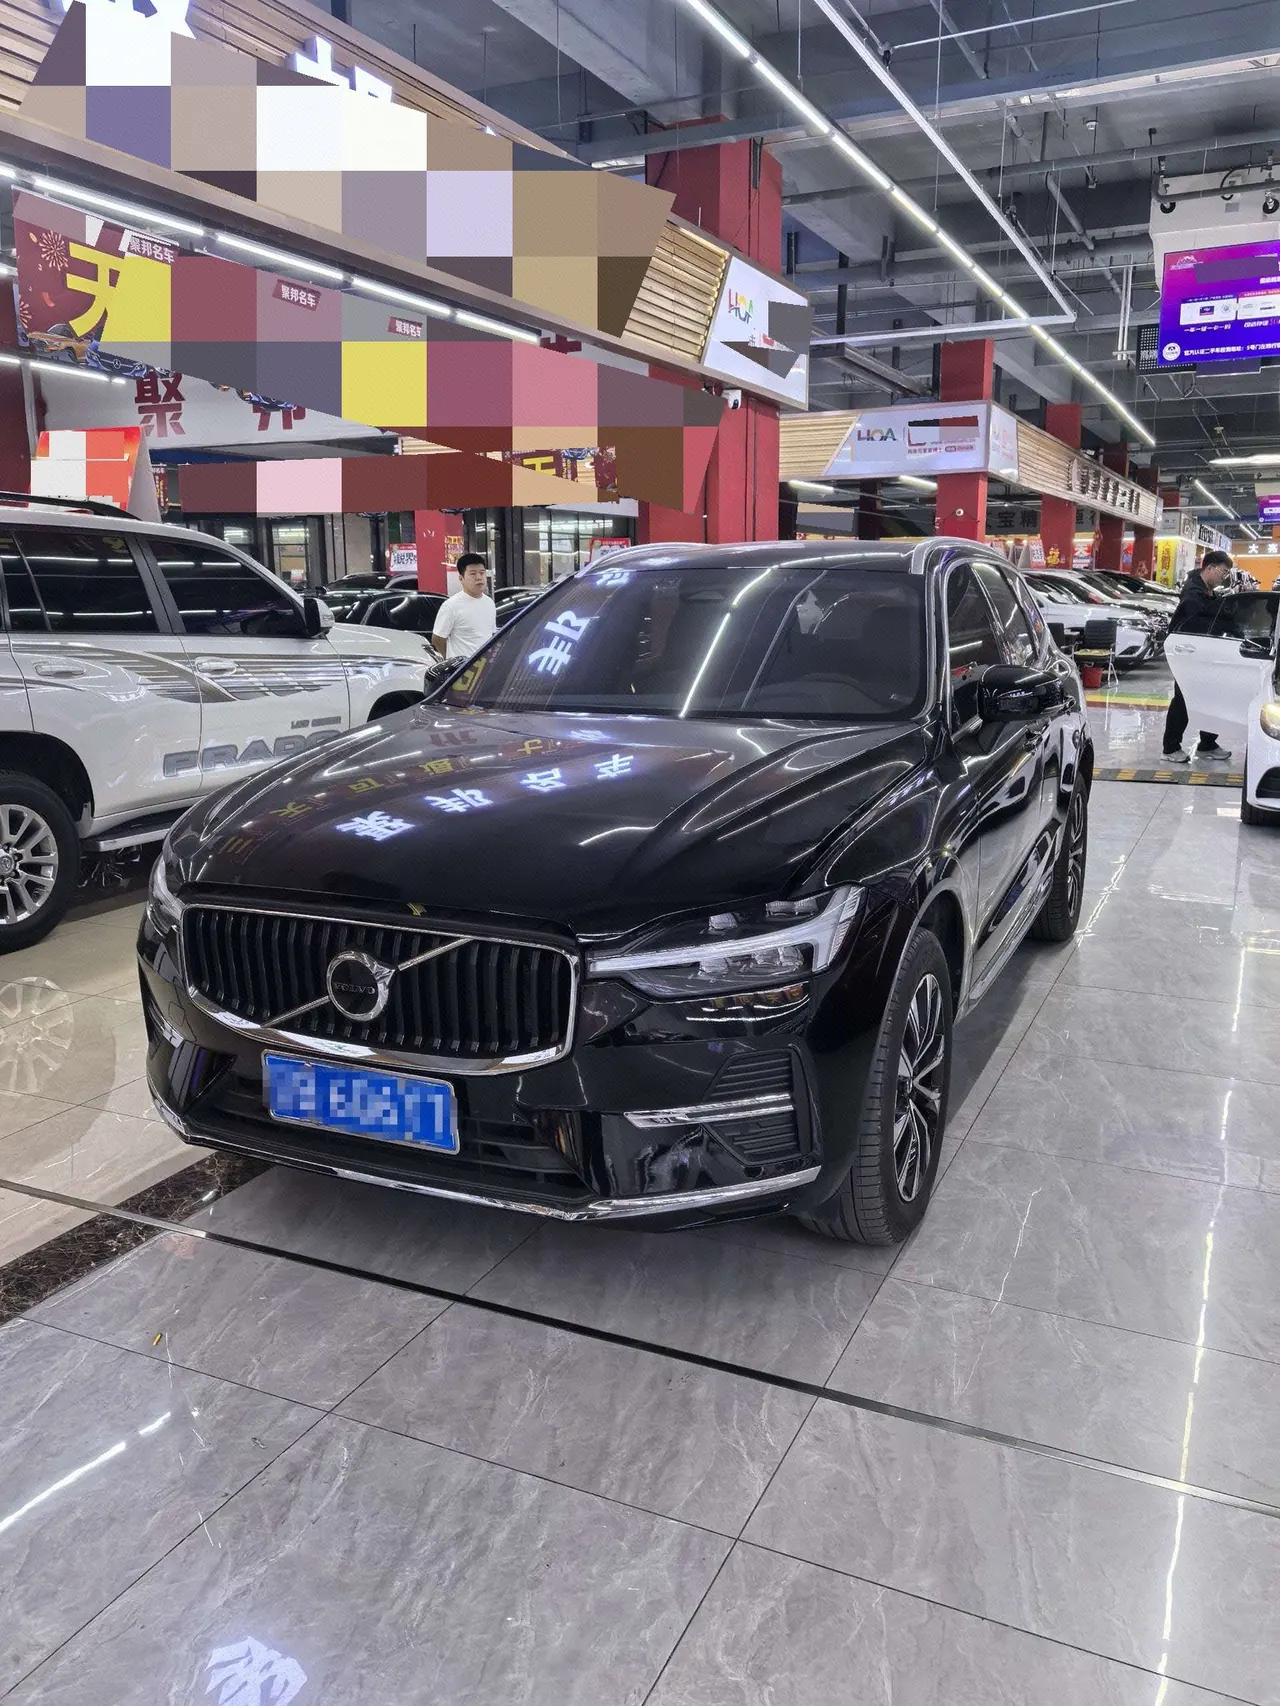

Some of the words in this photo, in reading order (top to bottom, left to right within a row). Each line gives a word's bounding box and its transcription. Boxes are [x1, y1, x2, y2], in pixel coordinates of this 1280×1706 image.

[129, 237, 175, 263] 聚邦名车
[281, 285, 316, 308] 聚邦名车
